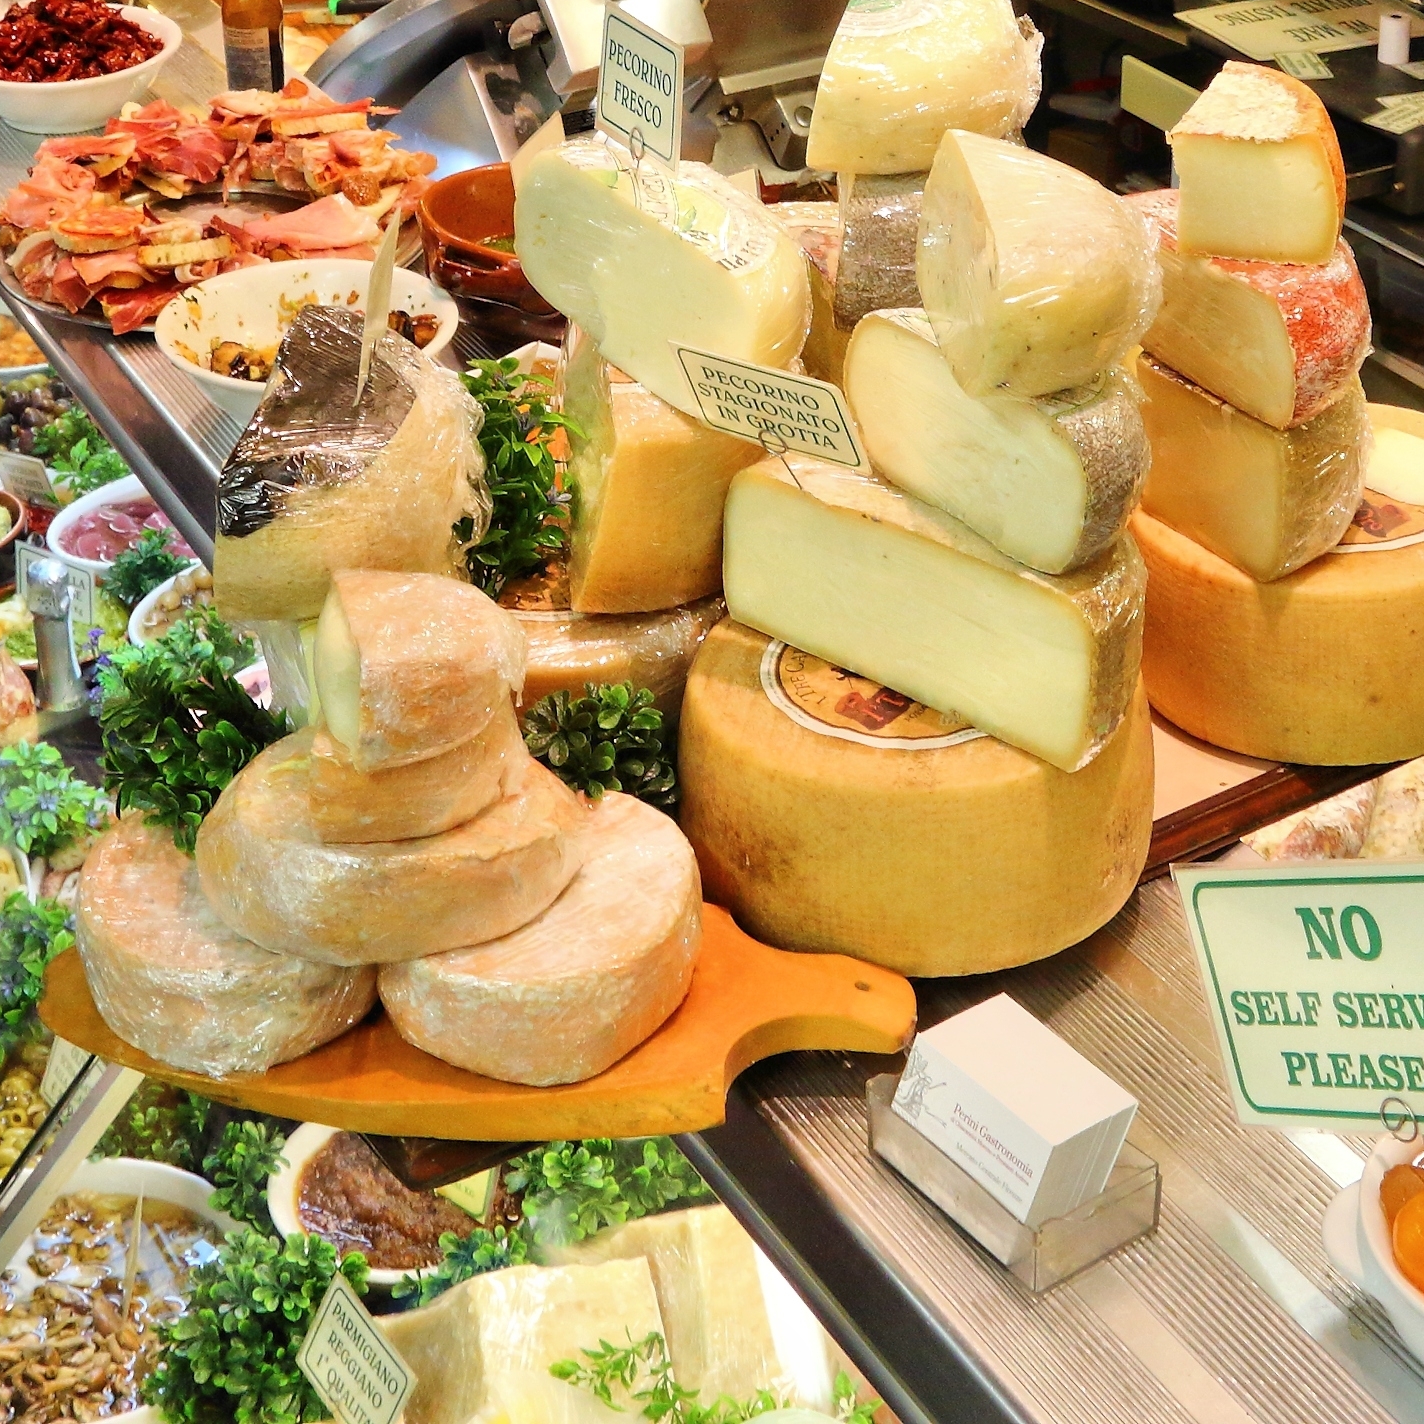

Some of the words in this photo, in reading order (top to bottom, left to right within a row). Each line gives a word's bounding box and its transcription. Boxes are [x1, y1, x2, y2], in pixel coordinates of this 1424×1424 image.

[1213, 5, 1298, 27] TASTING
[1282, 23, 1345, 44] MAKE
[1341, 19, 1379, 35] WE
[608, 38, 673, 97] PECORINO
[613, 80, 662, 129] FRESCO
[697, 382, 841, 434] STAGIONATO
[700, 365, 821, 411] PECORINO
[716, 404, 741, 423] IN
[746, 414, 839, 451] GROTTA
[1294, 904, 1384, 963] NO
[1229, 989, 1322, 1027] SELF
[953, 1102, 980, 1132] Perini
[979, 1125, 1035, 1179] Gastronomia
[327, 1329, 383, 1410] REGGIANO
[332, 1301, 399, 1396] PARMIGIANO
